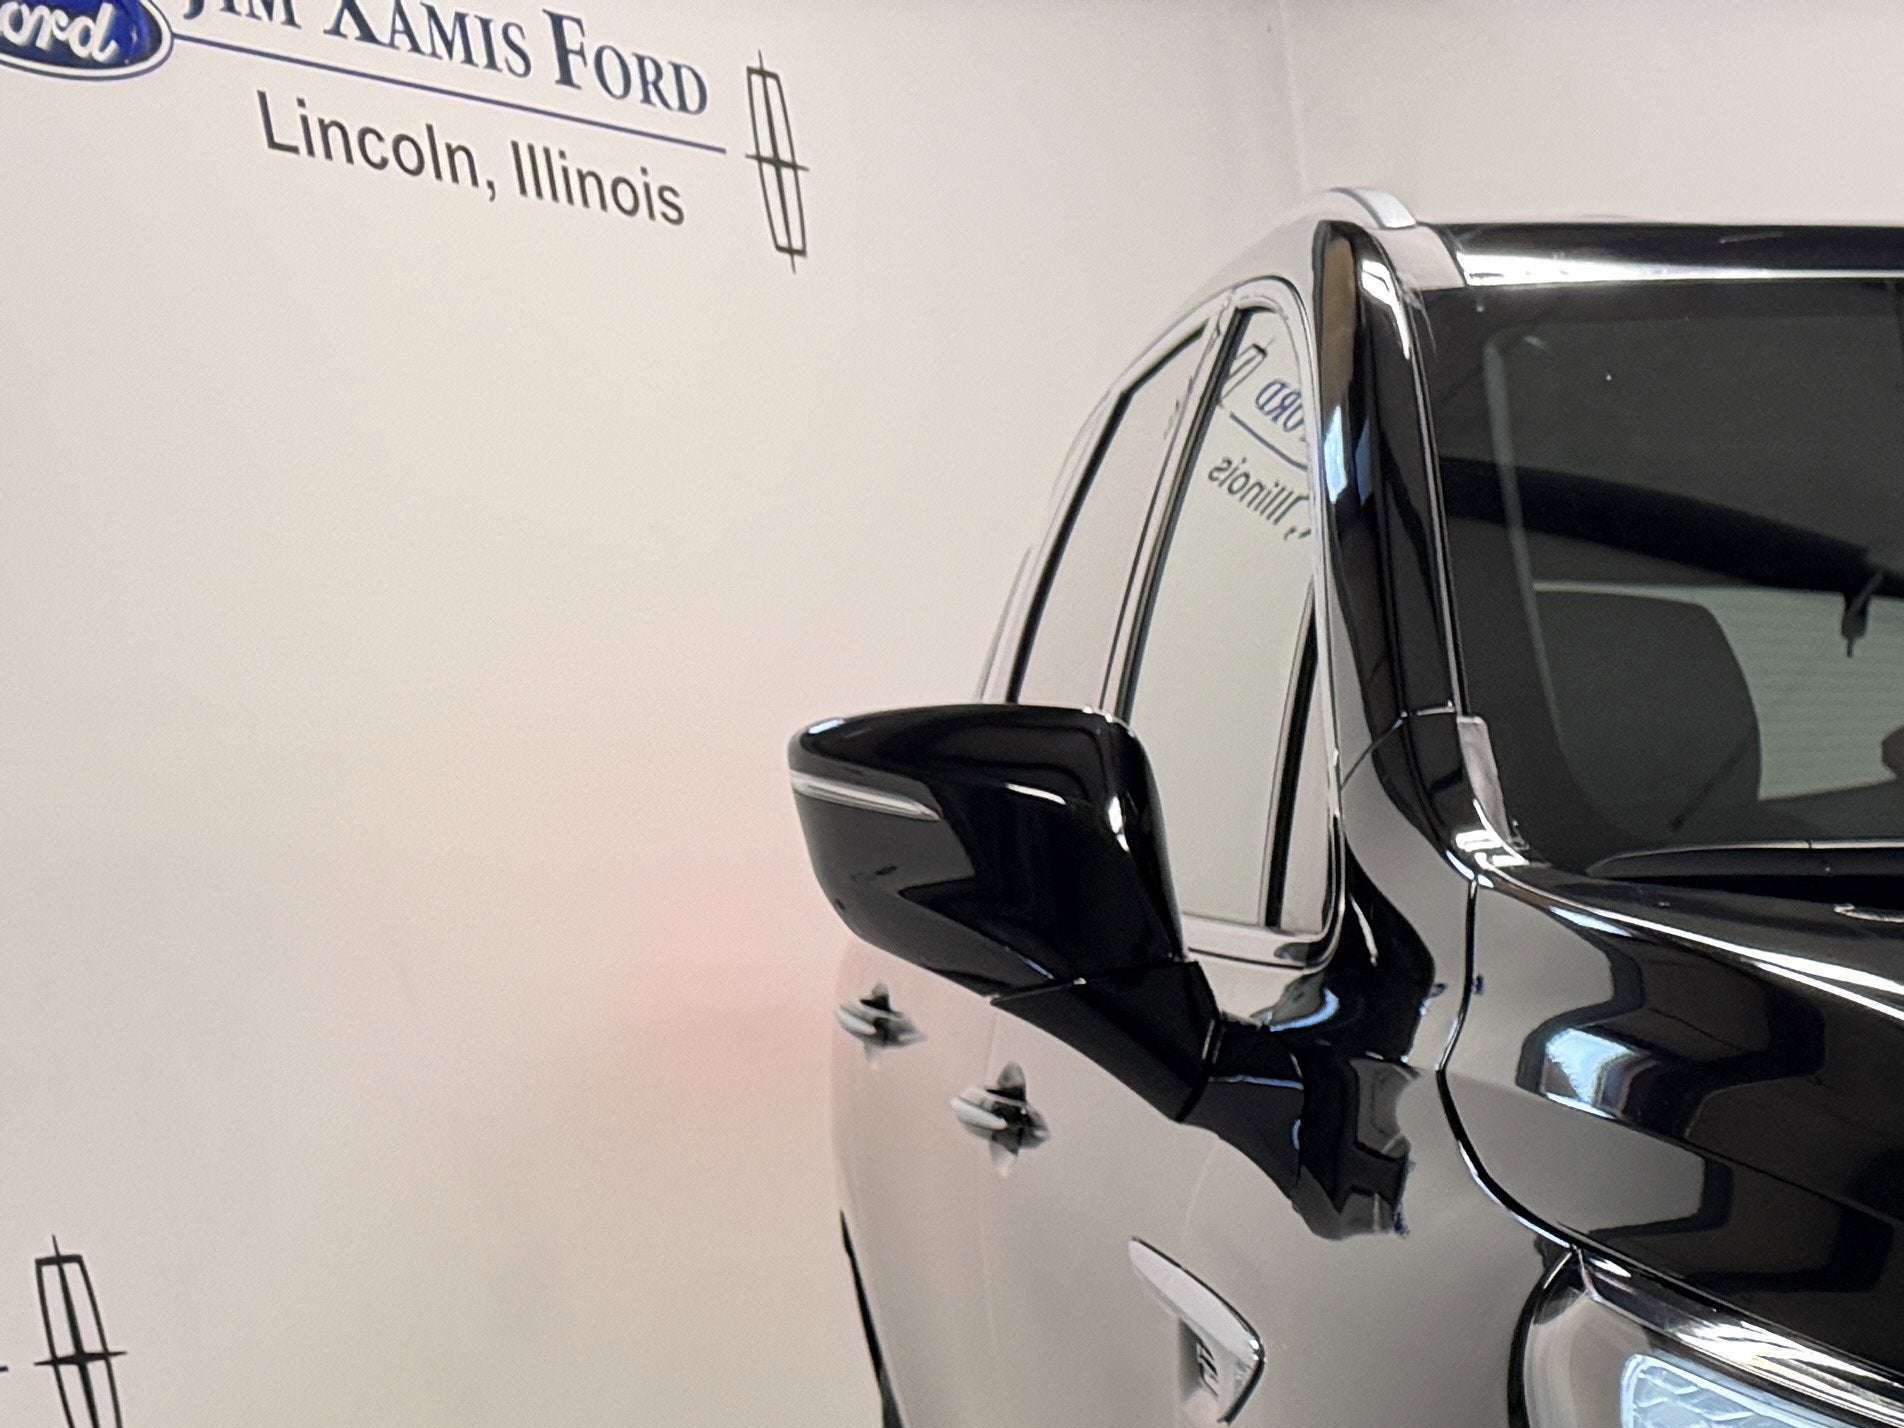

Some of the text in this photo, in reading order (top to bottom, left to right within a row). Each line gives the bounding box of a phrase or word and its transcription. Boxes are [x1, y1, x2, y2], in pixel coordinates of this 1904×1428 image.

[0, 2, 119, 63] ord
[543, 9, 708, 115] FORD
[257, 90, 685, 226] Lincoln, Illinois
